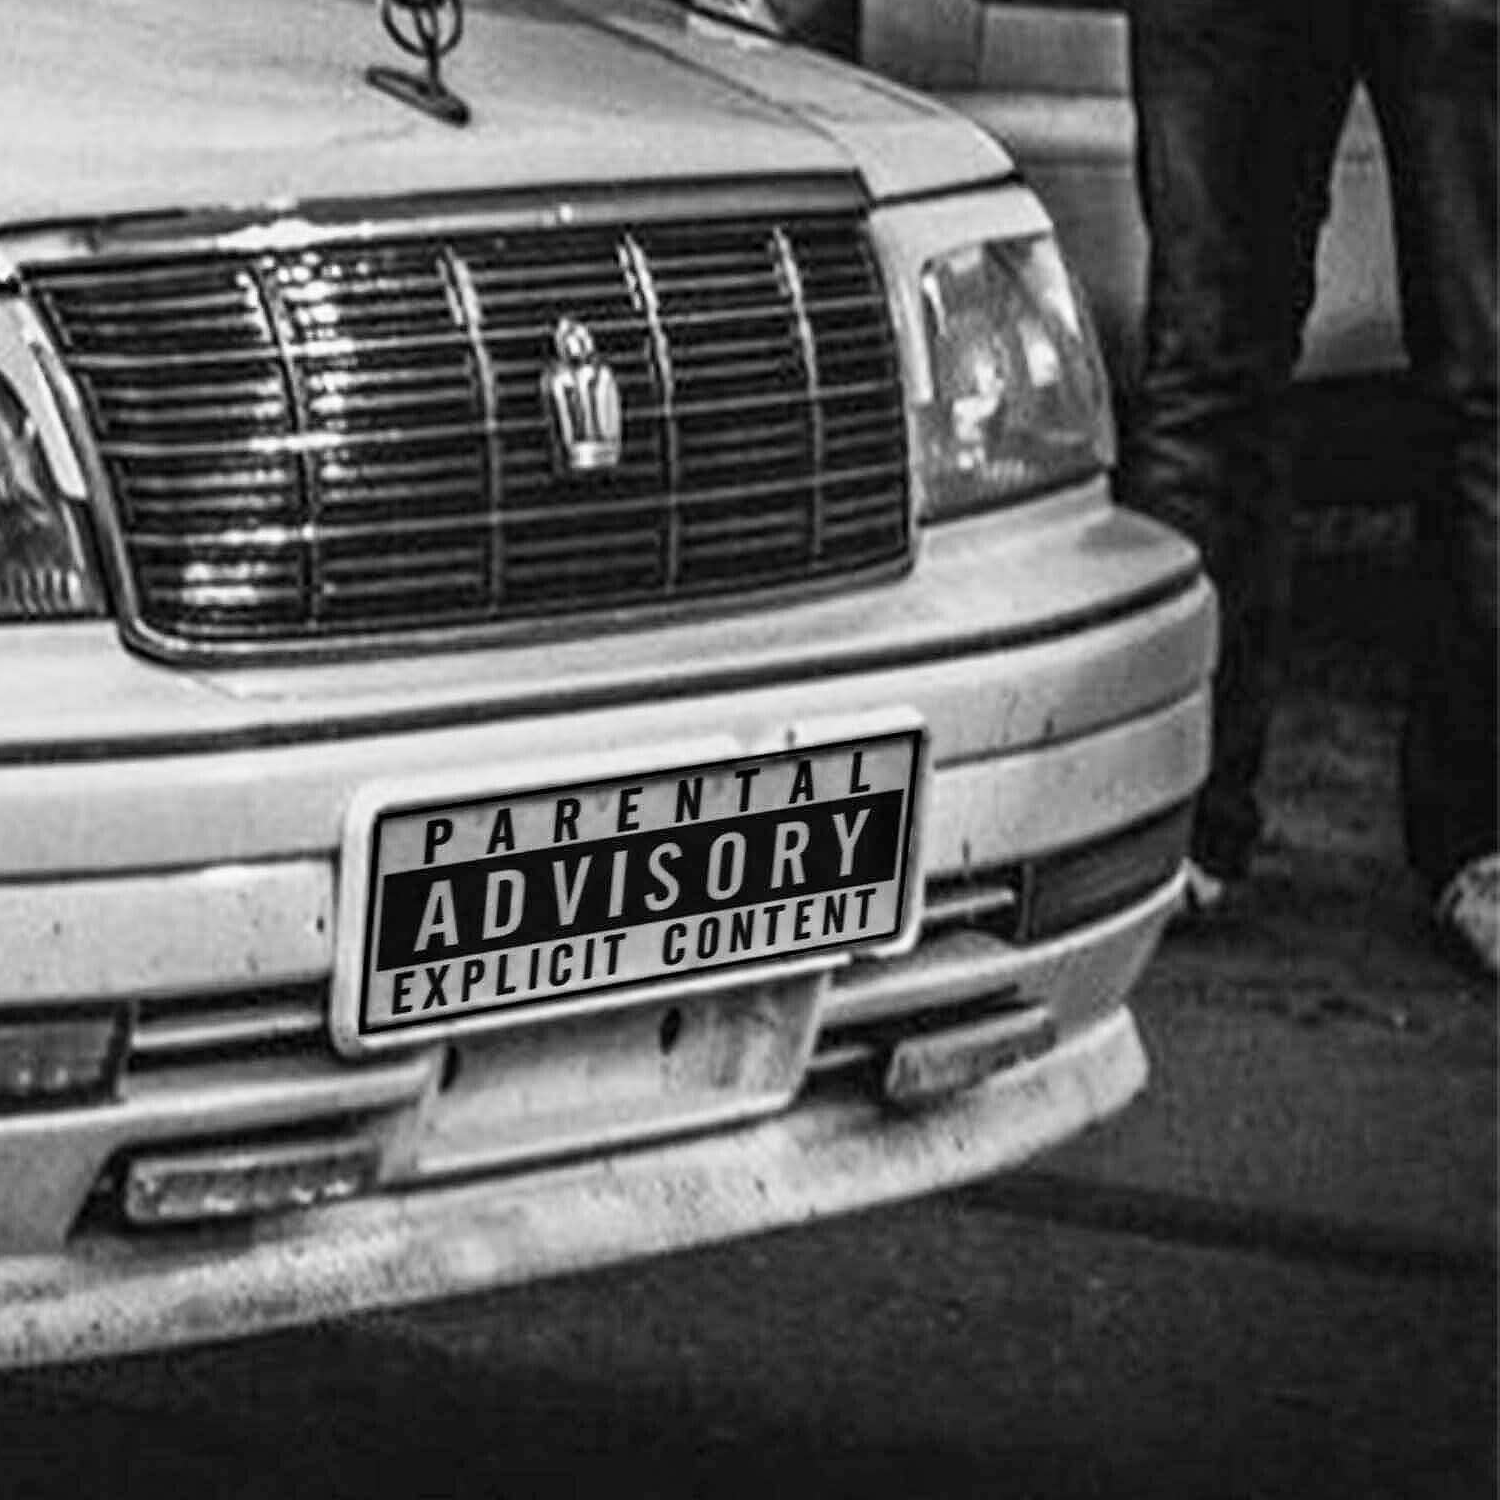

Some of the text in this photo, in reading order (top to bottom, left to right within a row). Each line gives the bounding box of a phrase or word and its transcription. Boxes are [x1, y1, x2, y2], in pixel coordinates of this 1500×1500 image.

[422, 751, 872, 866] PARENTAL
[412, 808, 874, 954] ADVISORY
[390, 887, 878, 1016] EXPLICIT CONTENT
